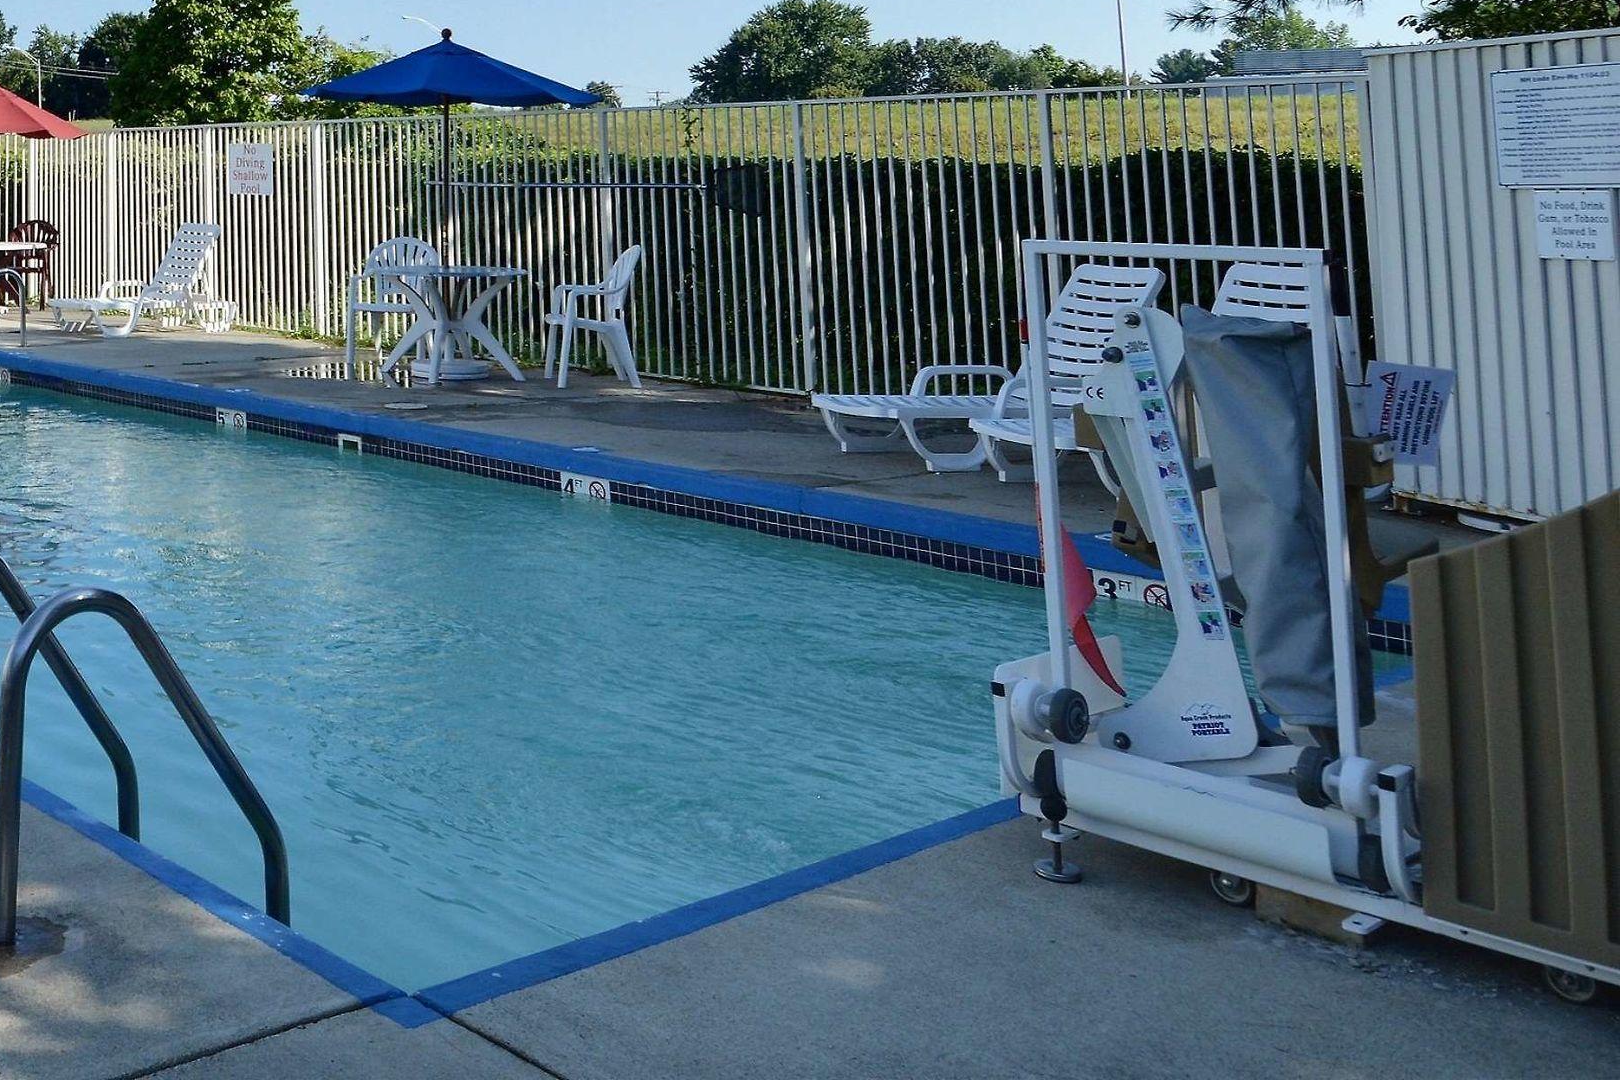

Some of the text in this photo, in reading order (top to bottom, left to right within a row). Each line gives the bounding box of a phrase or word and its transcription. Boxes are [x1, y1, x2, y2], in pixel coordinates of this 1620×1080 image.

[244, 145, 256, 154] No
[236, 158, 265, 170] Diving
[233, 170, 268, 180] Shallow
[241, 183, 259, 193] Pool
[1540, 202, 1552, 210] No
[1575, 215, 1609, 223] Tobacco
[1552, 227, 1585, 235] Allowed
[1555, 239, 1596, 249] Pool Area
[1380, 386, 1396, 433] TTENTION
[1097, 578, 1132, 599] 3 FT
